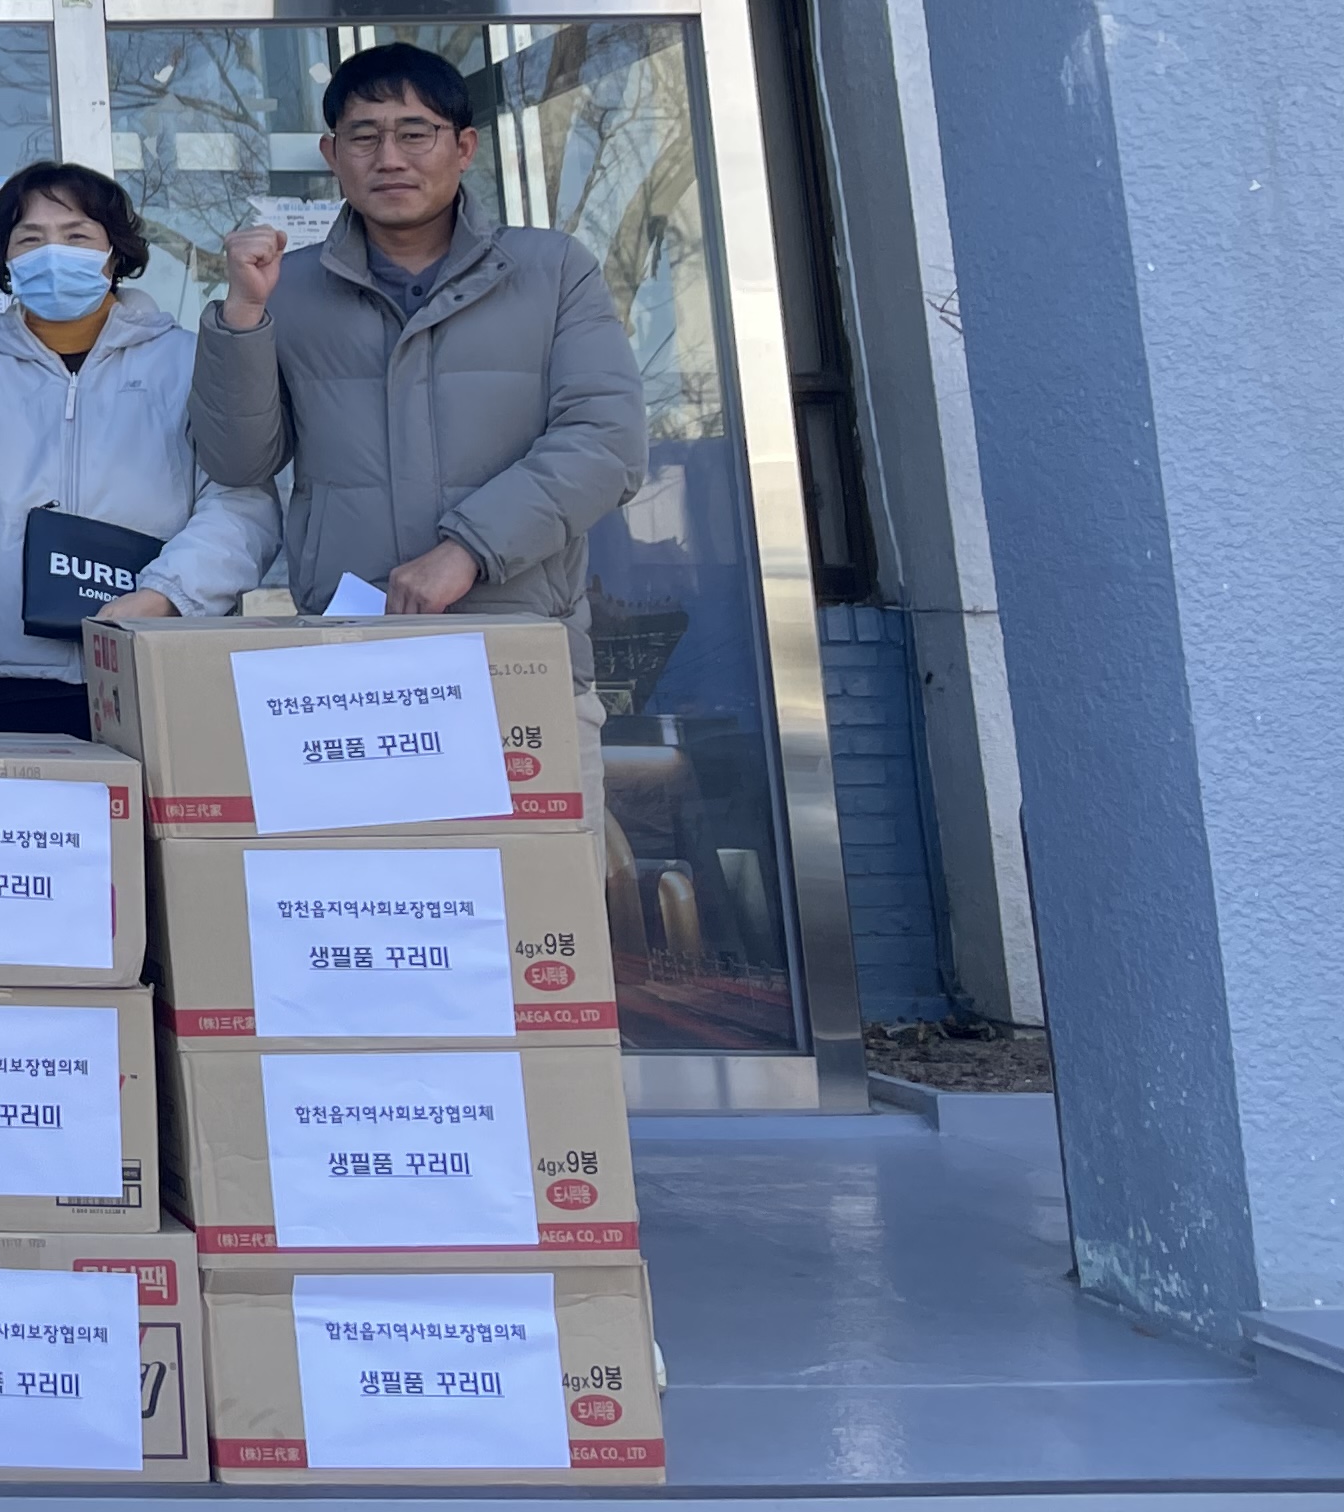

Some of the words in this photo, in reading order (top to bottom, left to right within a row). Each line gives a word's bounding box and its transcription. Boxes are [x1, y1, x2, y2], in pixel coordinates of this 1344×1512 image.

[50, 552, 134, 590] BURB
[267, 686, 461, 715] 합천읍지역사회보장협의체
[303, 738, 365, 763] 생필품
[374, 732, 440, 759] 꾸러미
[548, 799, 568, 812] LTD
[278, 901, 474, 919] 합천읍지역사회보장협의체
[310, 947, 373, 970] 생필품
[386, 947, 449, 970] 꾸러미
[580, 1009, 600, 1022] LTD
[0, 1105, 60, 1129] 꾸러미
[295, 1106, 493, 1124] 합천읍지역사회보장협의체
[330, 1153, 392, 1177] 생필품
[403, 1153, 470, 1177] 꾸러미
[603, 1229, 623, 1242] LTD
[325, 1322, 526, 1343] 합천읍지역사회보장협의체
[18, 1373, 79, 1398] 꾸러미
[361, 1371, 423, 1396] 생필품
[435, 1372, 501, 1397] 꾸러미
[627, 1447, 647, 1460] LTD
